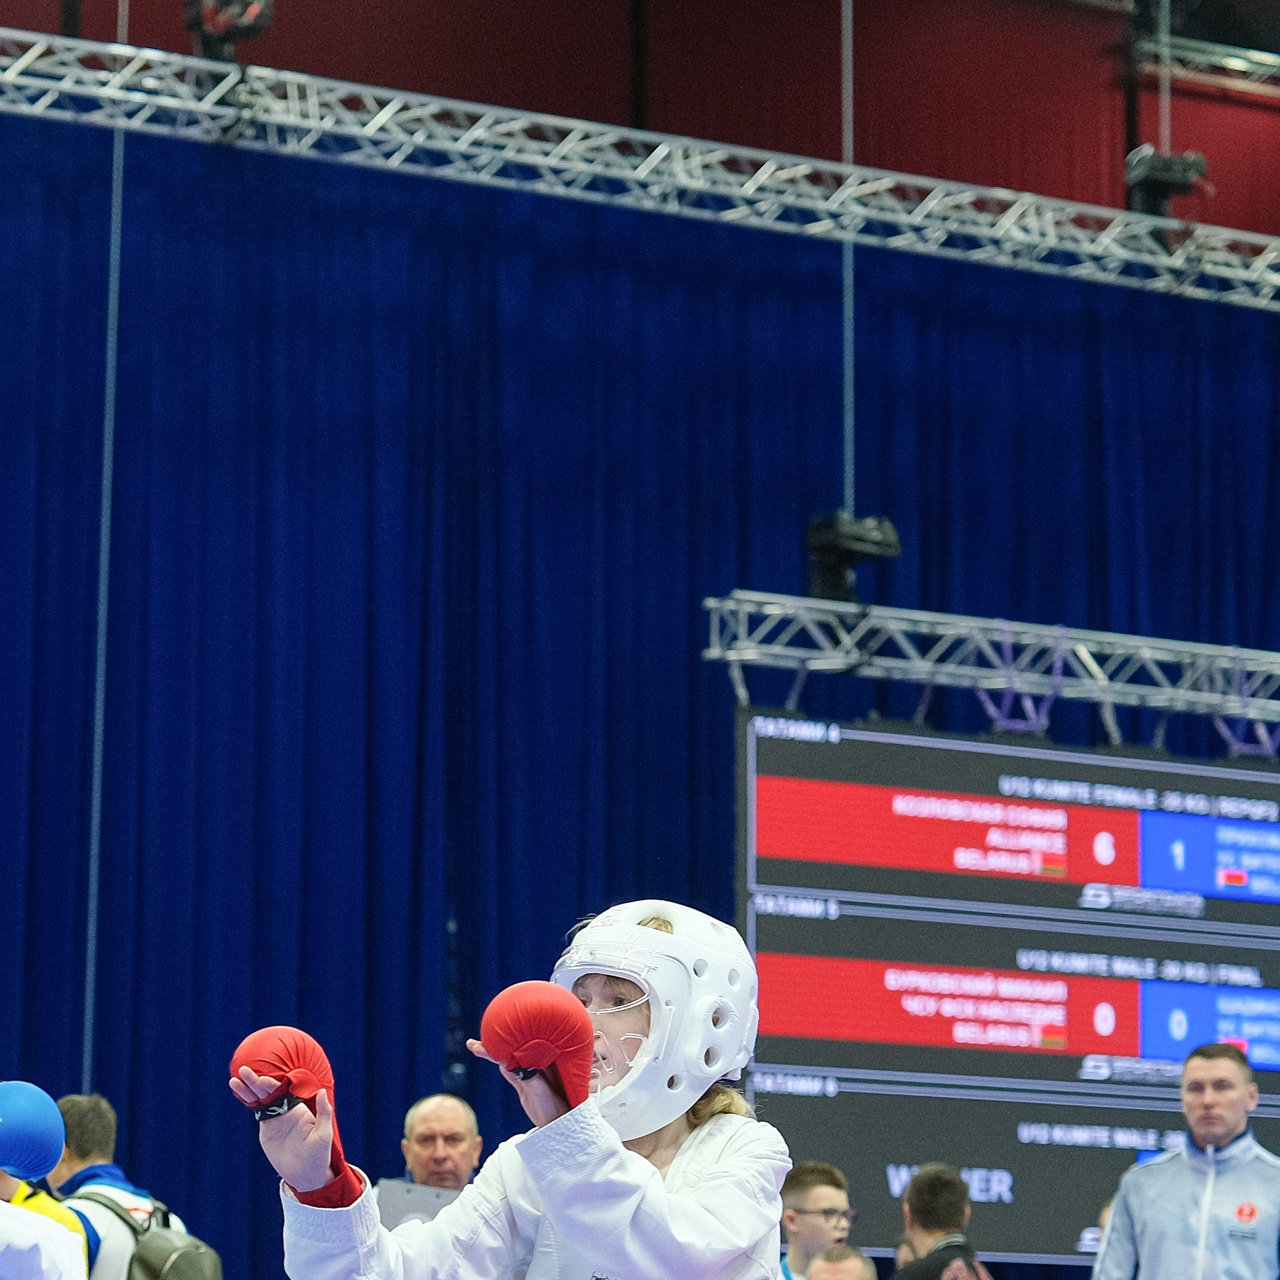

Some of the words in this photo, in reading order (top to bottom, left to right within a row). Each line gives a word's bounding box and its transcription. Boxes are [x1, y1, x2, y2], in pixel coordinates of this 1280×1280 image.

[1093, 831, 1116, 865] 6
[1172, 839, 1186, 871] 1
[1093, 1002, 1116, 1036] 0
[1169, 1009, 1187, 1041] 0
[885, 1163, 1014, 1203] WER
